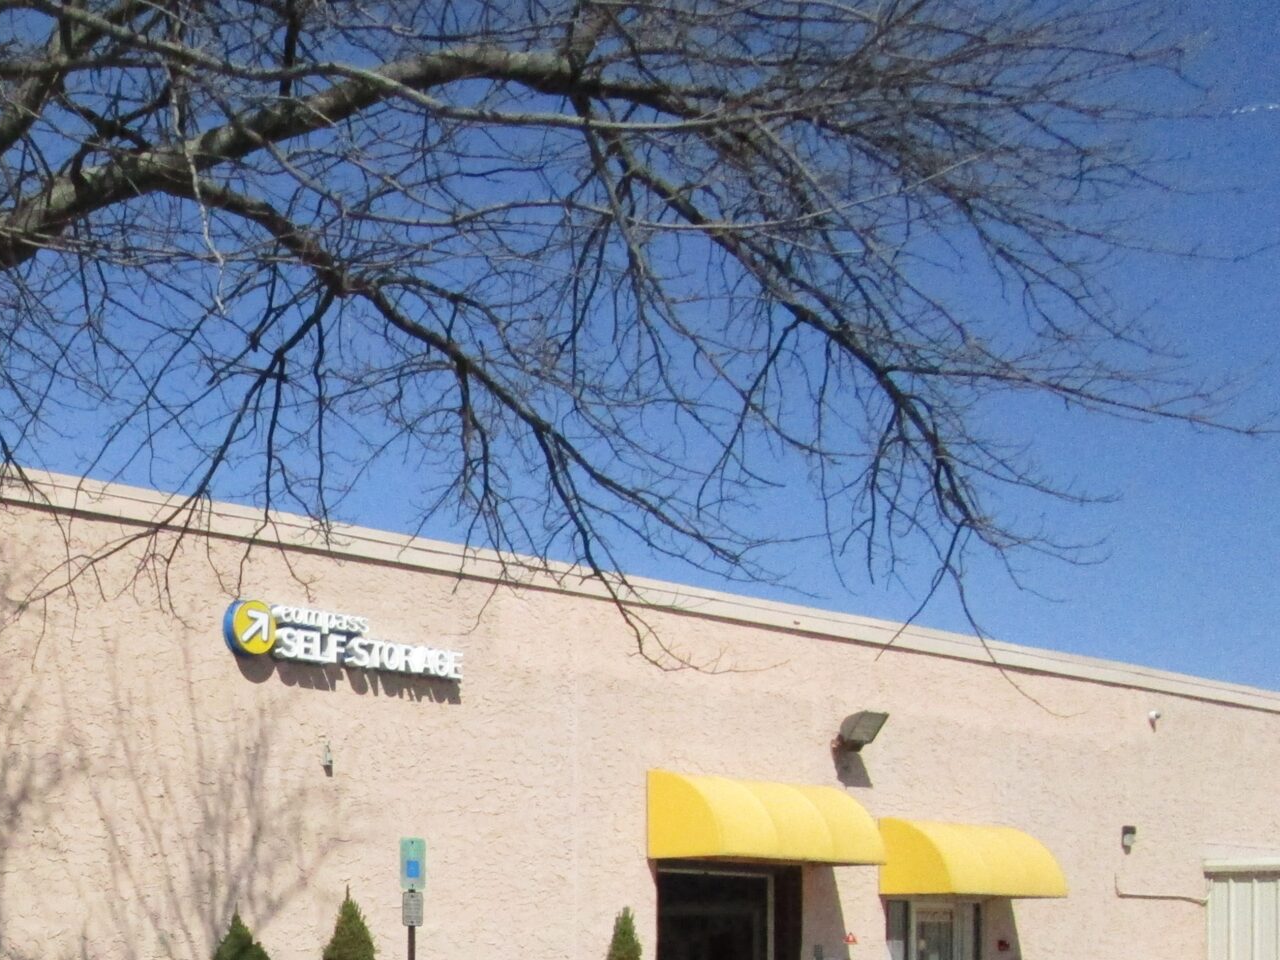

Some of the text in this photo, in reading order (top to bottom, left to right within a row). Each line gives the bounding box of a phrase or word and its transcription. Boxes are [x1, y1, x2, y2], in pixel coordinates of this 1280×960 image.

[272, 606, 369, 634] compass
[275, 627, 464, 679] SELF STORAGE
